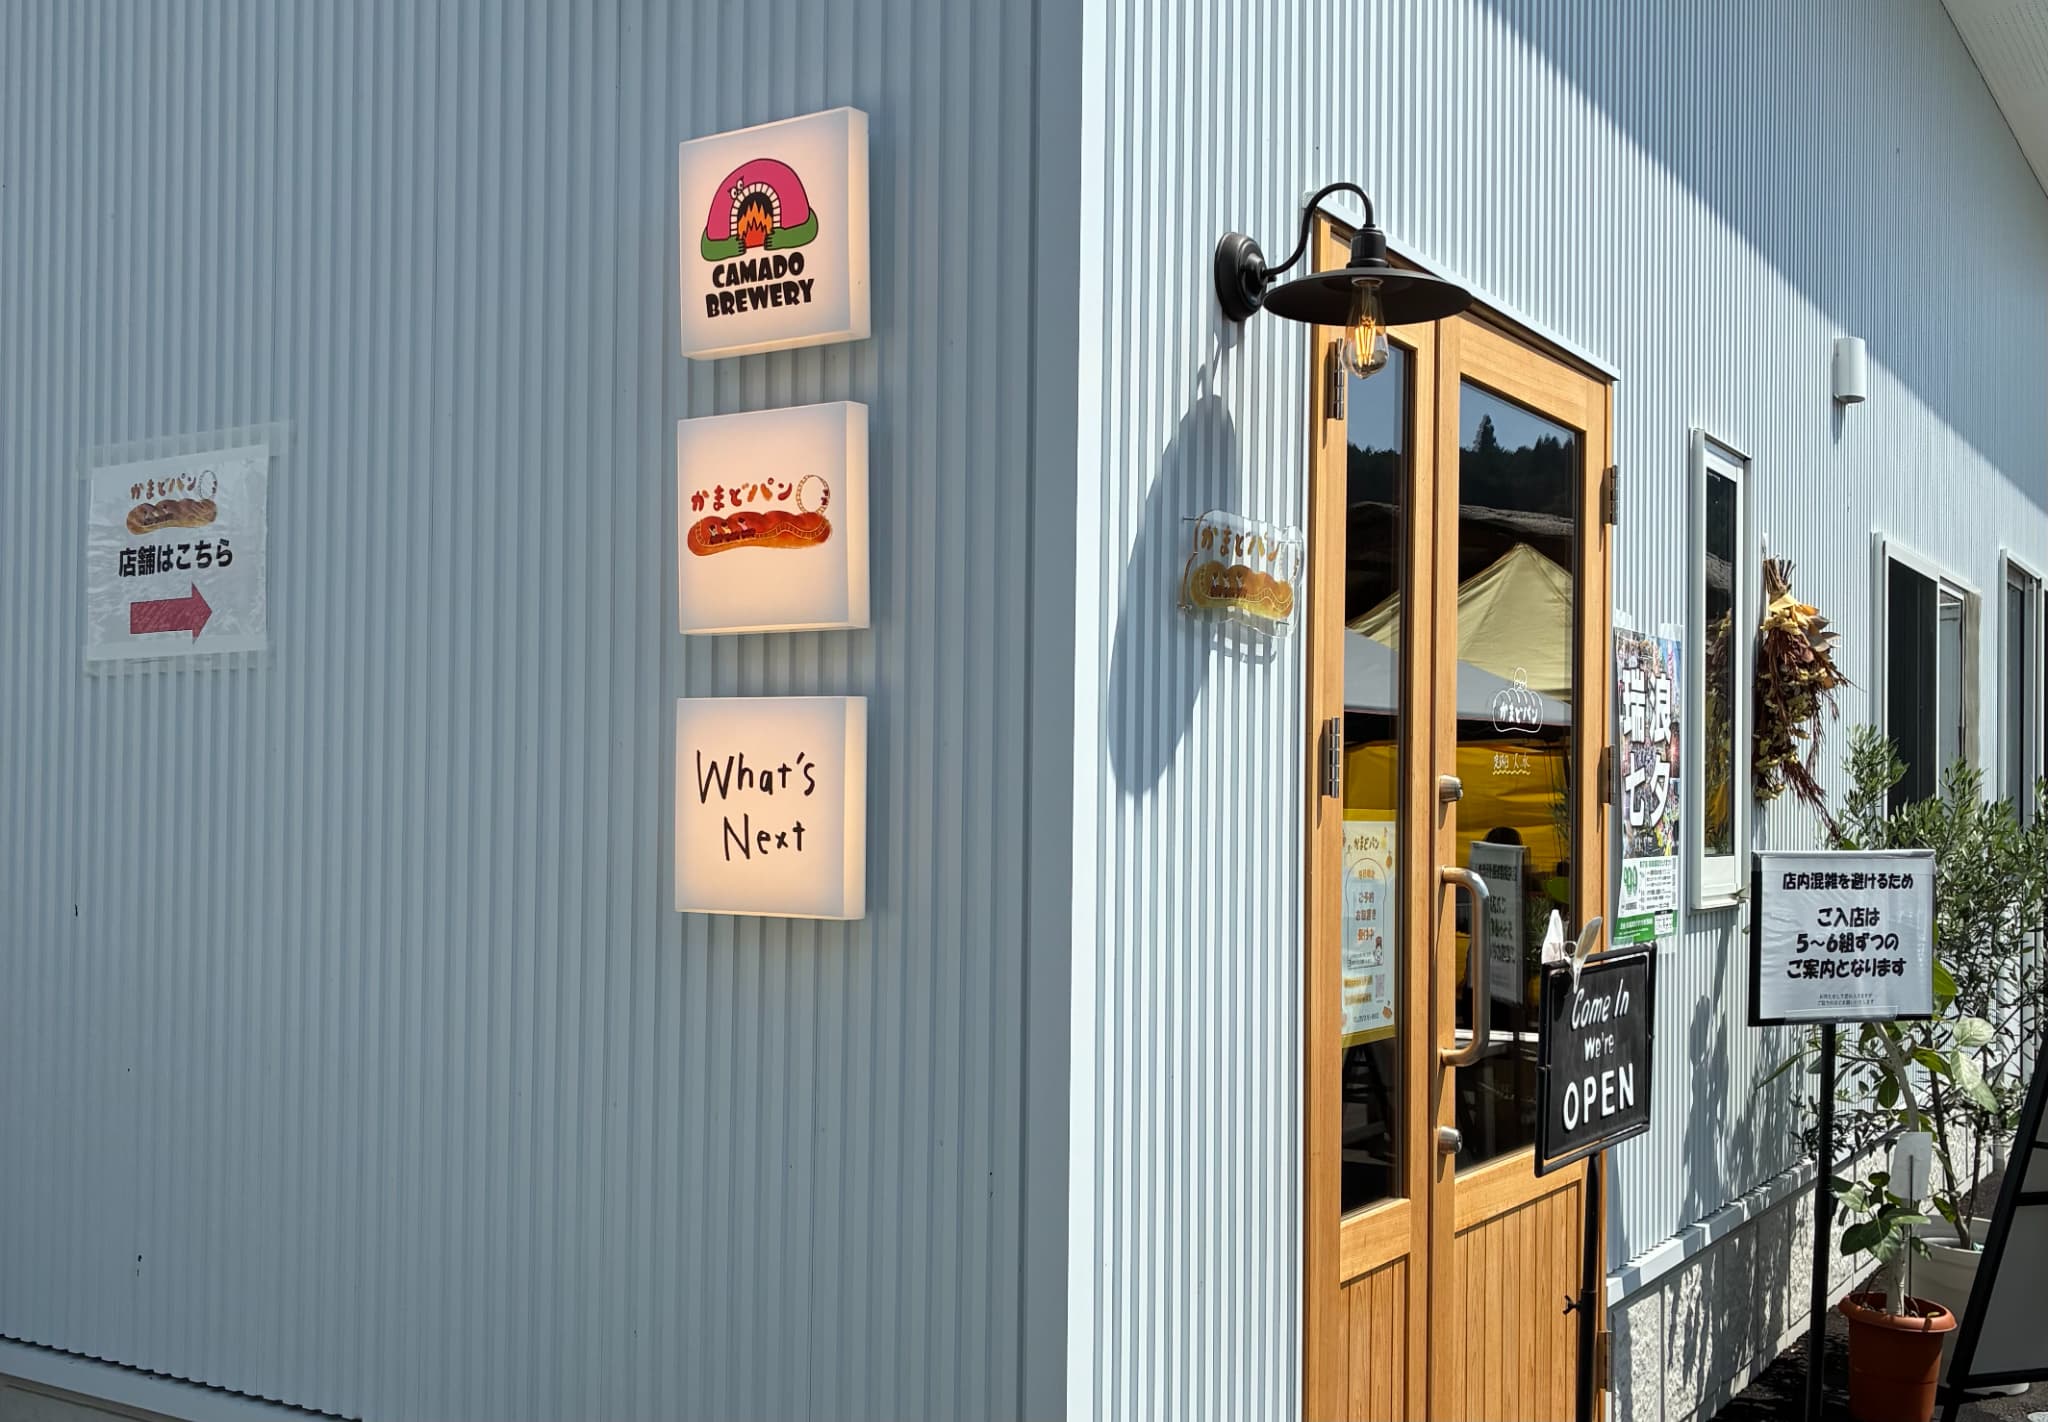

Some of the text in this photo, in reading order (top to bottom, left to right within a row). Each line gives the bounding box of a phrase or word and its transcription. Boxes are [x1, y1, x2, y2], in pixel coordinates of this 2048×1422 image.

[712, 252, 805, 288] CAMADO
[705, 279, 815, 318] BREWERY
[131, 472, 197, 500] かまどパン
[691, 477, 793, 512] かまどパン
[118, 537, 233, 577] 店舗はこちら
[1201, 525, 1282, 562] かまどパン
[1500, 701, 1538, 725] かまどパン
[1622, 668, 1672, 745] 瑞浪
[696, 749, 816, 805] What's
[1625, 753, 1671, 828] 七夕
[723, 813, 806, 862] Next
[1783, 872, 1914, 890] 店内混雑を避けるため
[1817, 907, 1880, 927] ご入店は
[1796, 932, 1899, 954] 5〜6組ずつの
[1787, 958, 1907, 979] ご案内となります
[1571, 978, 1630, 1030] Come In
[1562, 1062, 1635, 1131] OPEN
